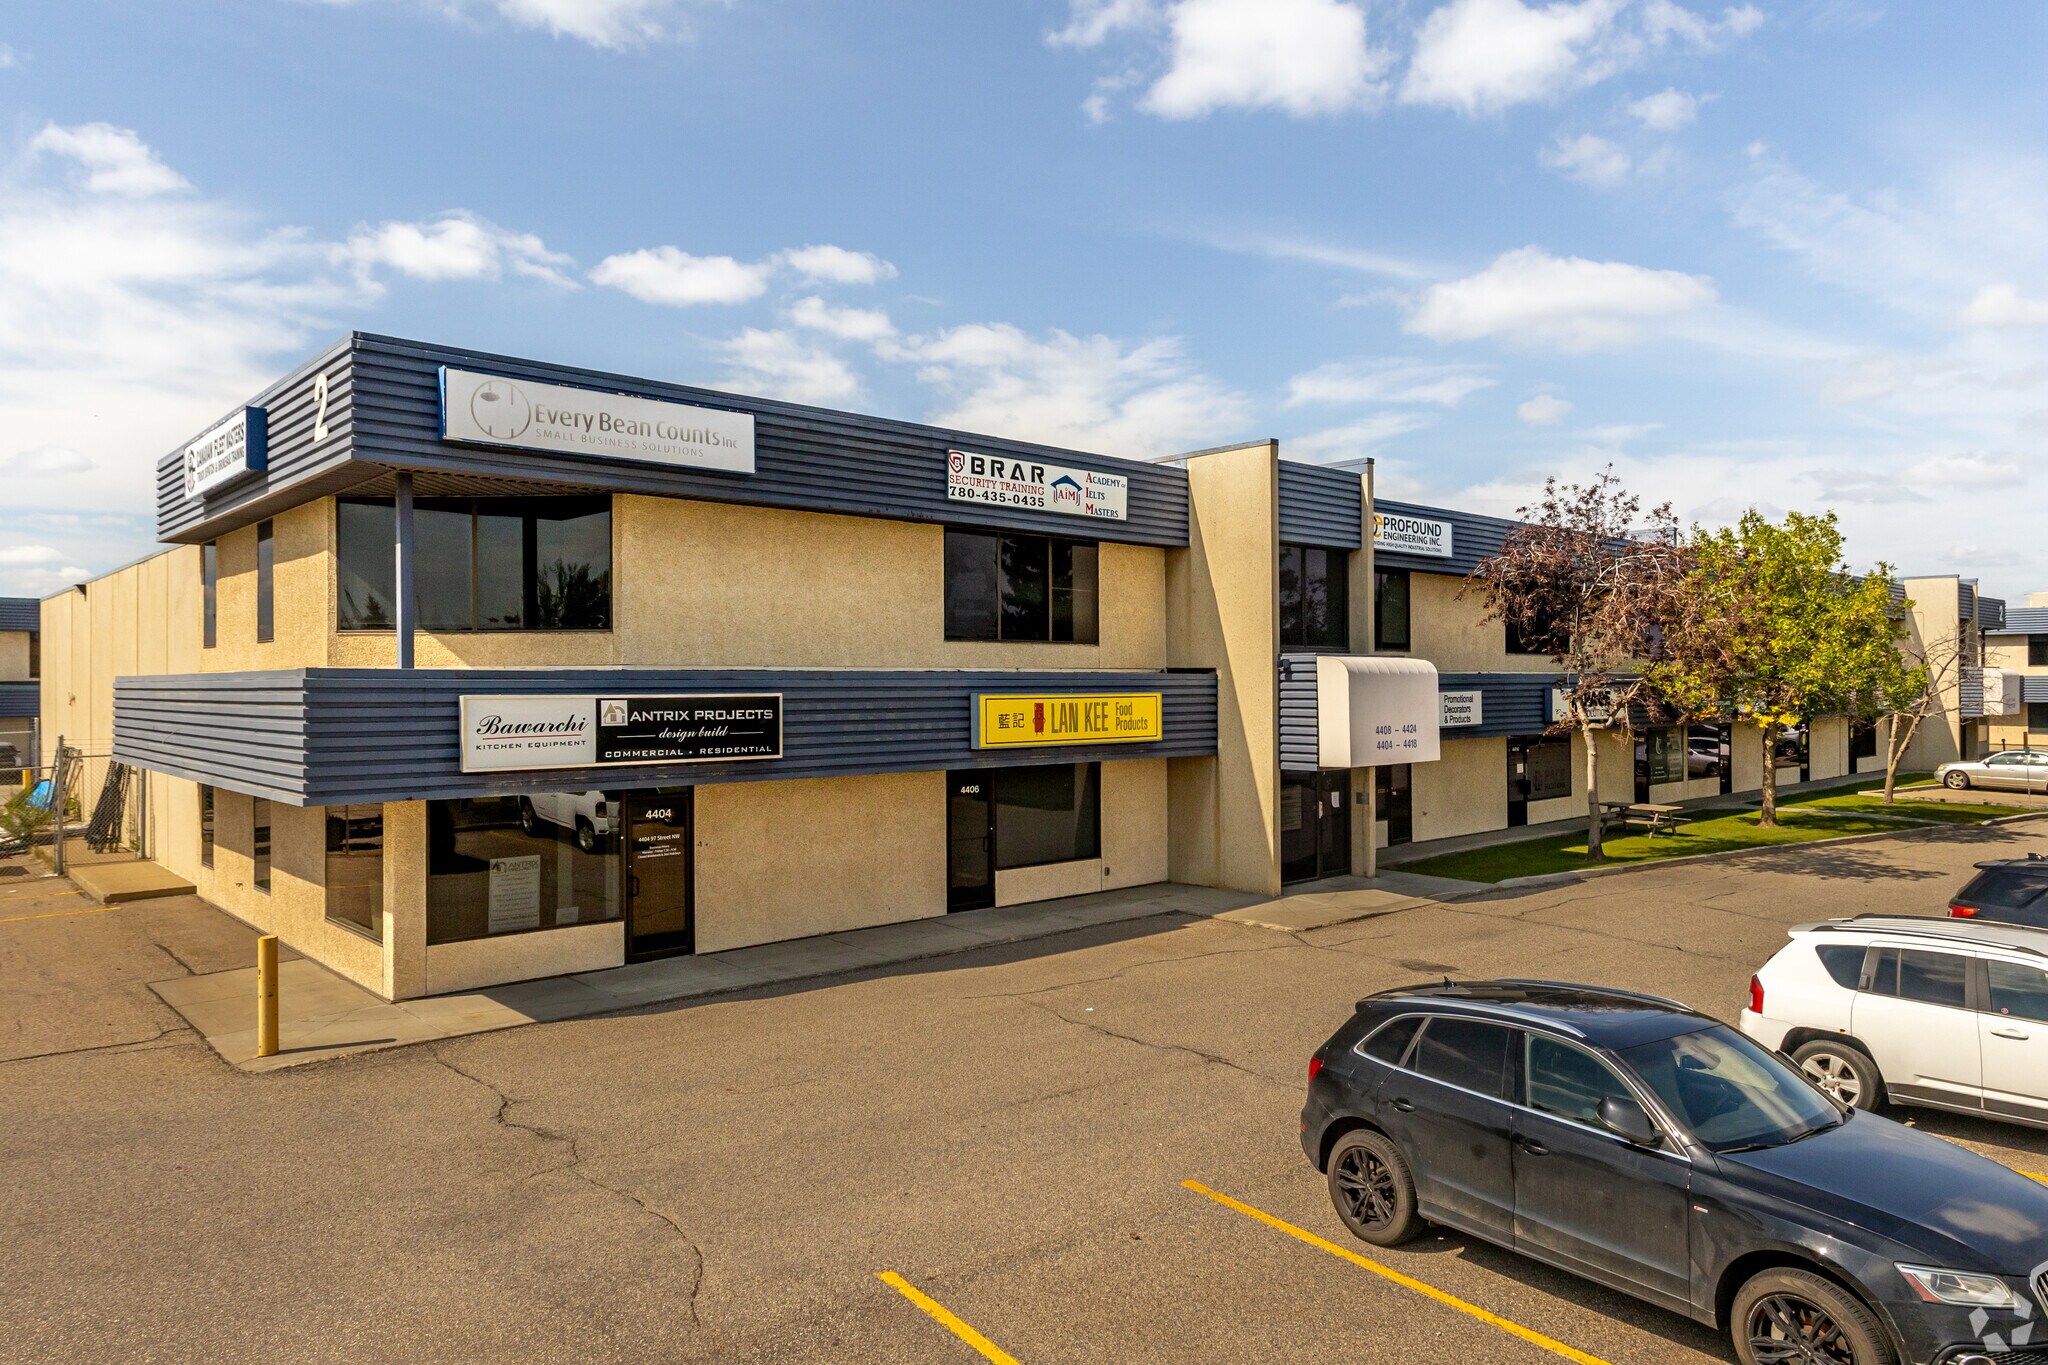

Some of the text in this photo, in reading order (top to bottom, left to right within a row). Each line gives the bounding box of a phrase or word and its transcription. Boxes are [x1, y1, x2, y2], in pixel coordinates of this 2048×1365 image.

[314, 373, 328, 443] 2
[535, 403, 738, 449] Every Bean Counts Inc
[213, 434, 226, 458] FLEET
[536, 428, 704, 458] SMALL BUSINESS SOLUTIONS
[970, 456, 1045, 484] BRAR
[949, 474, 1045, 496] SECURITY TRAINING
[949, 486, 1045, 507] 780-435-0435
[1085, 487, 1105, 500] IELTS
[1085, 503, 1119, 518] MASTERS
[1383, 516, 1442, 537] PROFOUND
[1383, 531, 1442, 546] ENGINEERING INC.
[1443, 694, 1474, 703] Promotional
[630, 708, 773, 722] ANTRIX PROJECTS
[1115, 701, 1133, 716] Food
[1443, 705, 1471, 714] Decorators
[1051, 701, 1109, 733] LAN KEE
[1115, 716, 1148, 732] Products
[1443, 715, 1471, 724] & Products
[476, 714, 589, 736] Bawarchi
[1375, 725, 1392, 735] 4408
[1402, 724, 1417, 733] 4424
[658, 726, 729, 740] design build
[475, 740, 587, 750] KITCHEN EQUIPMENT
[1376, 740, 1393, 750] 4404
[1403, 739, 1418, 749] 4418
[604, 746, 772, 759] COMMERCIAL RESIDENTIAL
[960, 785, 980, 794] 4406
[645, 808, 672, 819] 4404
[508, 860, 539, 870] ANTRIX
